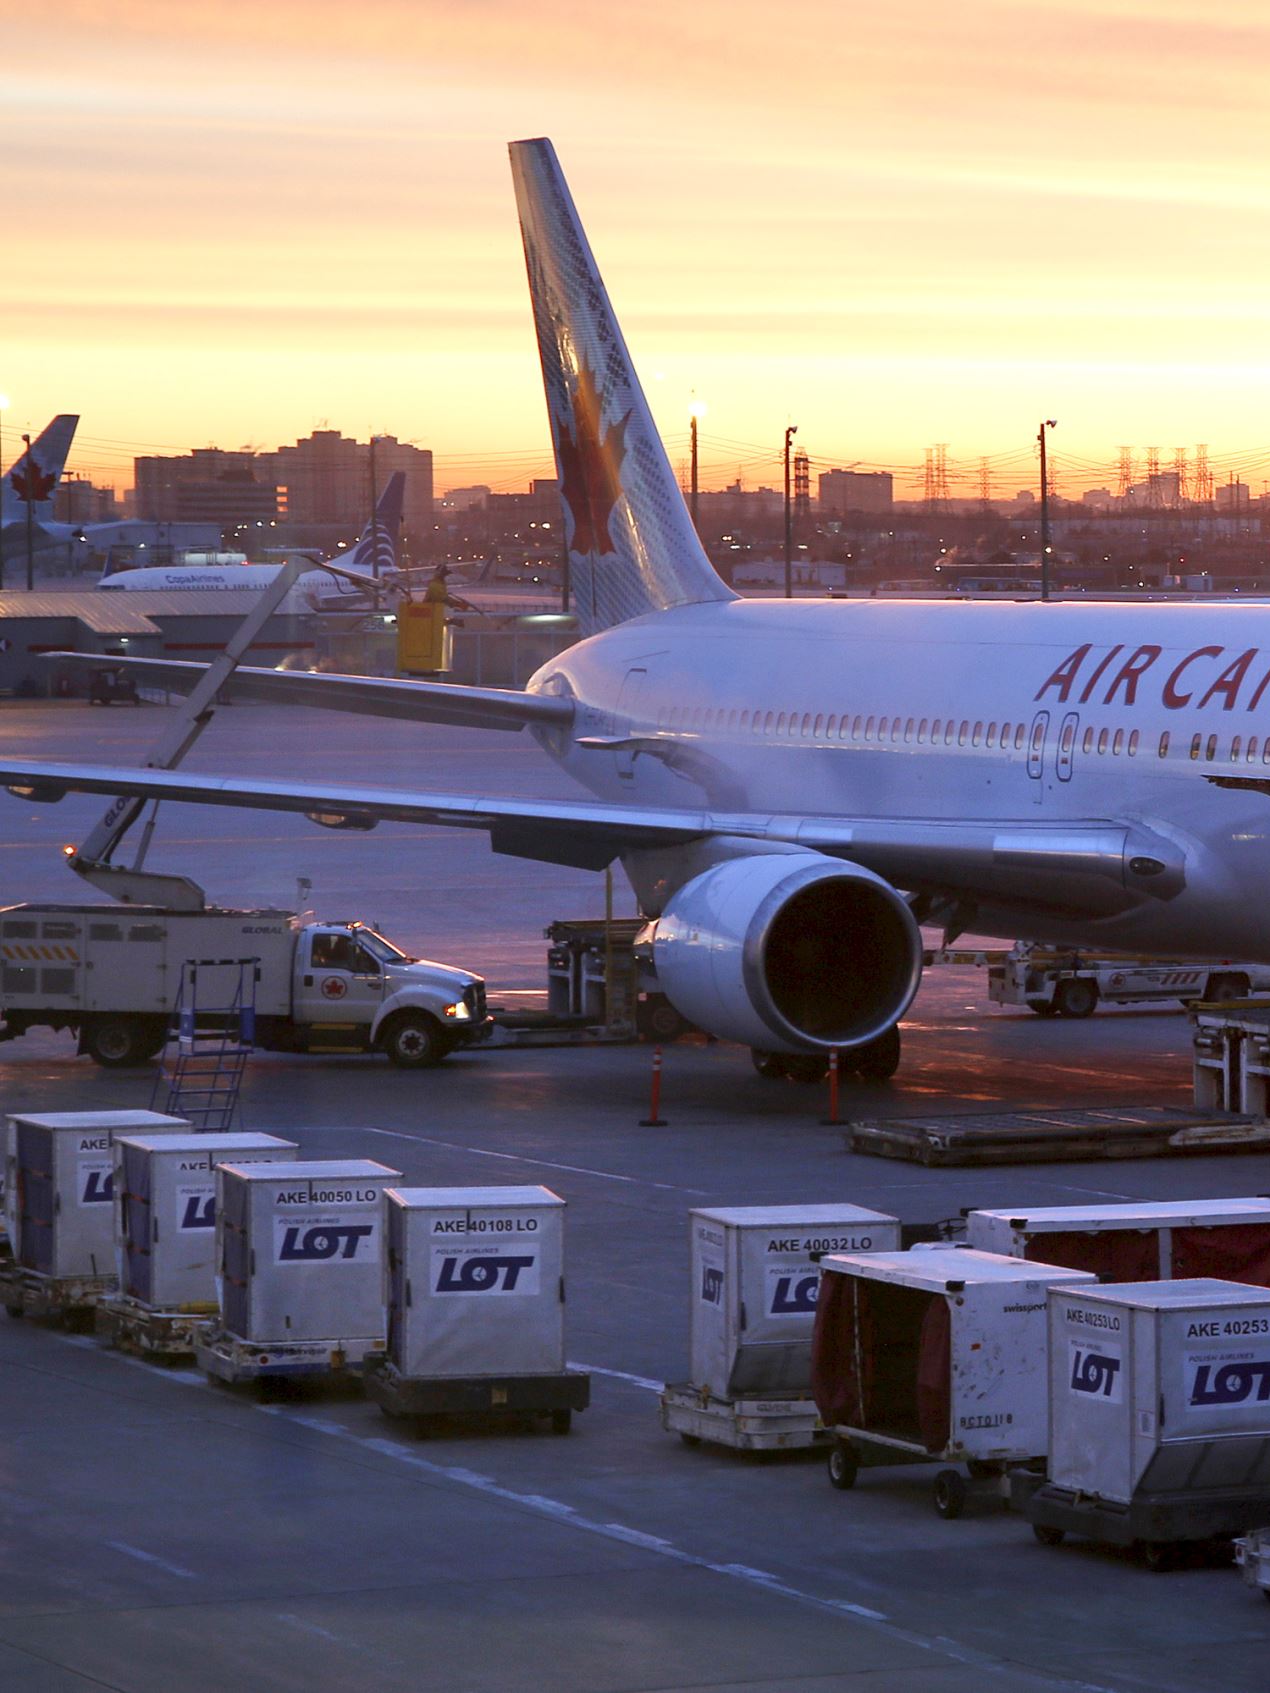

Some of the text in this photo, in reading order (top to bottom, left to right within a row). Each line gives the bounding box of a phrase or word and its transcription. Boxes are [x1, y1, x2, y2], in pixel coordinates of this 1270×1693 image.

[1034, 643, 1162, 705] AIR
[242, 926, 283, 935] GLOBAL
[80, 1139, 107, 1150] AKE
[277, 1190, 376, 1204] AKE 40050 LO
[434, 1219, 537, 1233] AKE 40108 LO
[279, 1225, 373, 1260] LOT
[768, 1237, 872, 1252] AKE 40032 LO
[436, 1256, 534, 1292] LOT
[702, 1265, 723, 1305] LOT
[1003, 1302, 1048, 1314] swissport
[1067, 1308, 1084, 1323] AKE
[1108, 1316, 1120, 1330] LO
[1187, 1323, 1219, 1337] AKE
[1223, 1319, 1268, 1335] 40253
[1071, 1350, 1120, 1396] LOT
